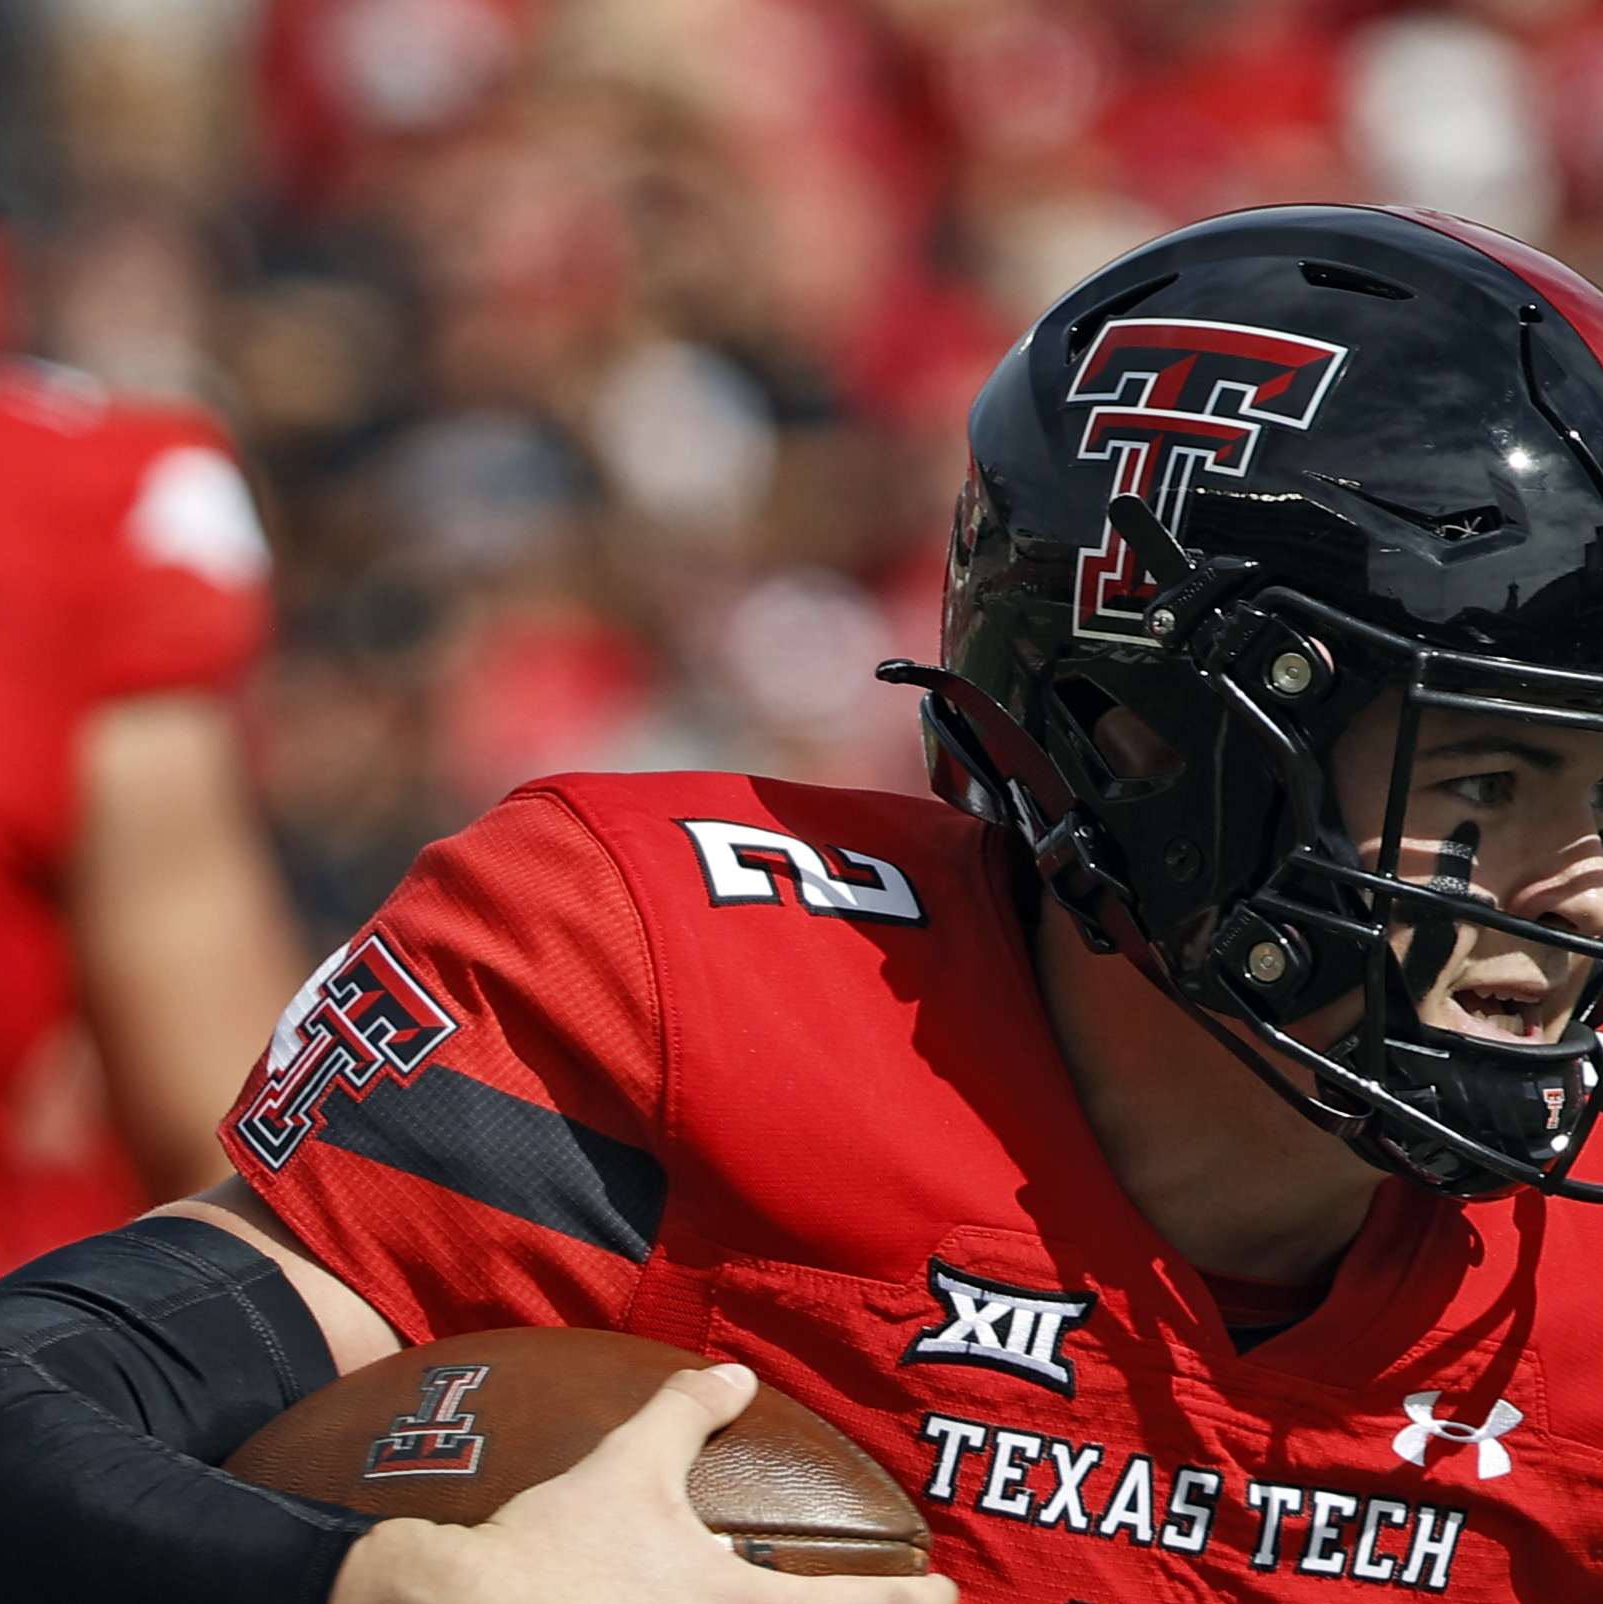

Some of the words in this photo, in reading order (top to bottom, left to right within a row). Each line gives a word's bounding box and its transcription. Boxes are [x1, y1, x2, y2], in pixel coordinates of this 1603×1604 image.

[671, 817, 928, 928] 2
[901, 1258, 1098, 1396] XII
[921, 1411, 1223, 1556] TEXAS
[1247, 1476, 1466, 1592] TECH
